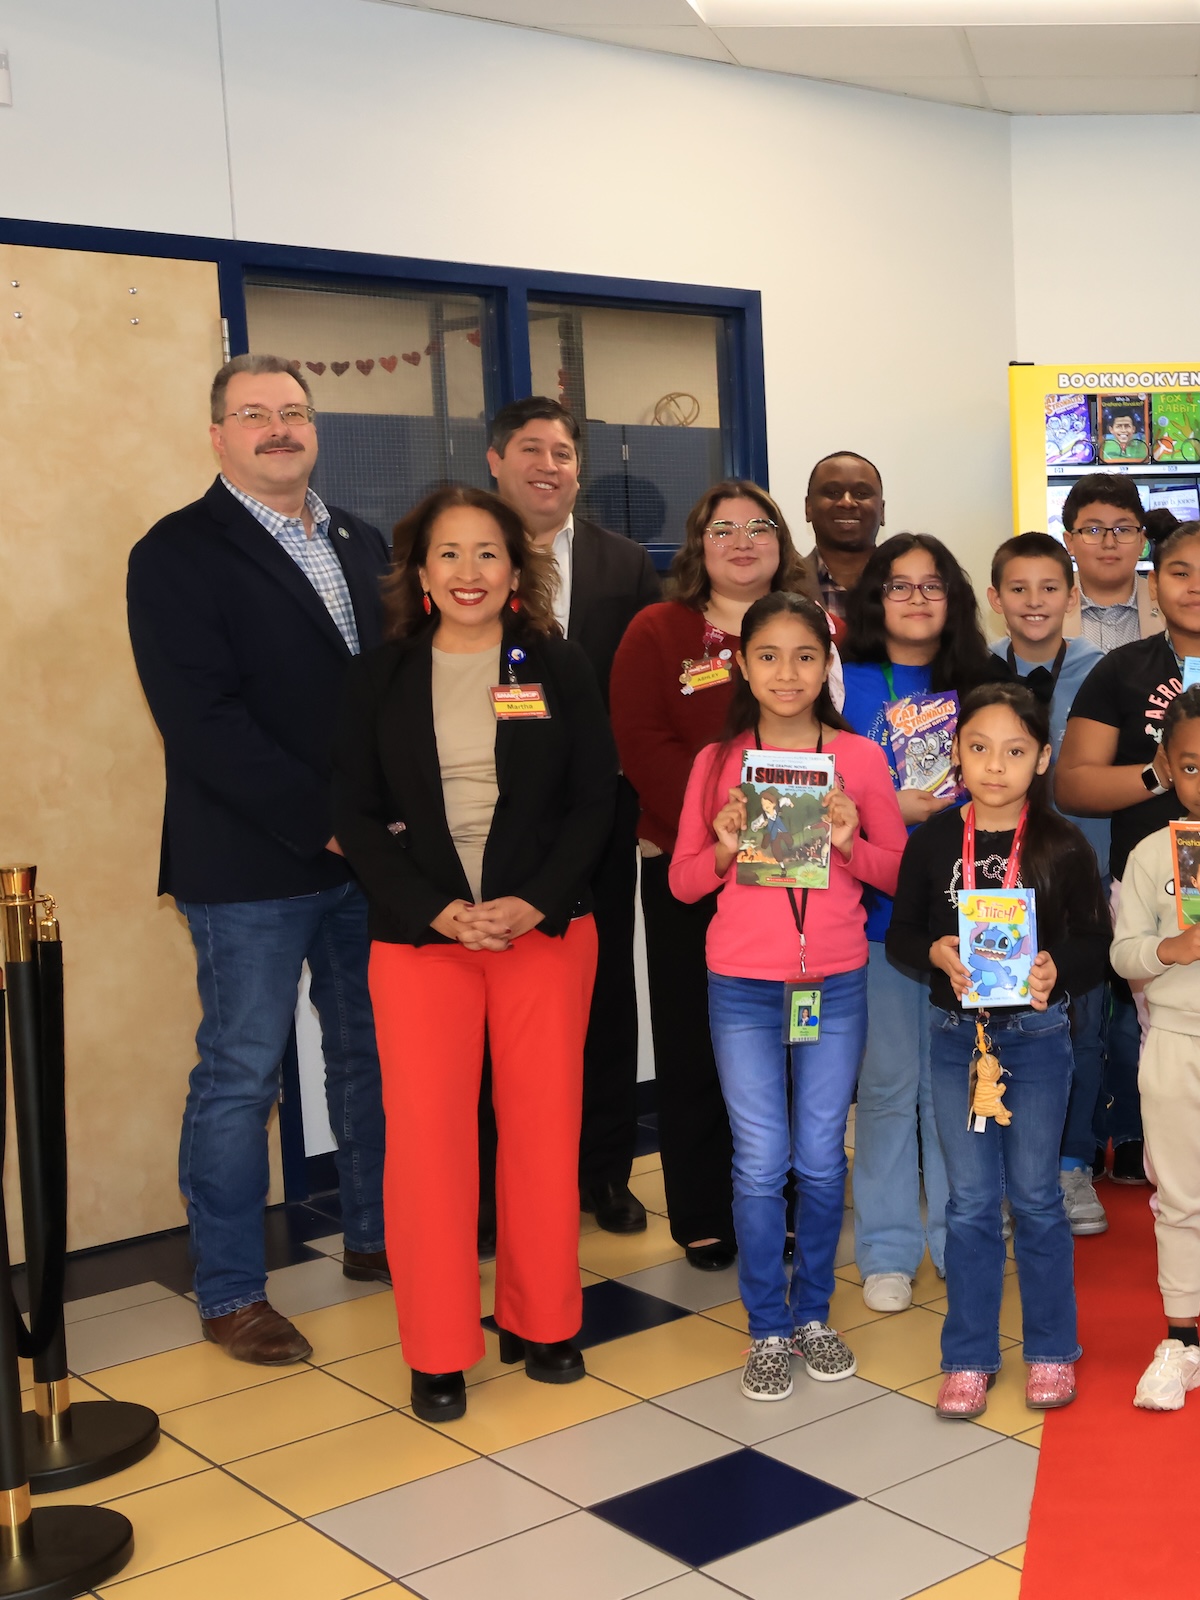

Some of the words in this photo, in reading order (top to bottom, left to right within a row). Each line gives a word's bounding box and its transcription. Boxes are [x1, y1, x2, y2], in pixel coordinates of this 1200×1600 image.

[1160, 394, 1182, 402] FOX
[697, 673, 719, 682] ASHLEY
[891, 703, 917, 729] CAT
[903, 700, 956, 736] STRONAUTS
[746, 766, 753, 782] I
[755, 767, 828, 786] SURVIVED
